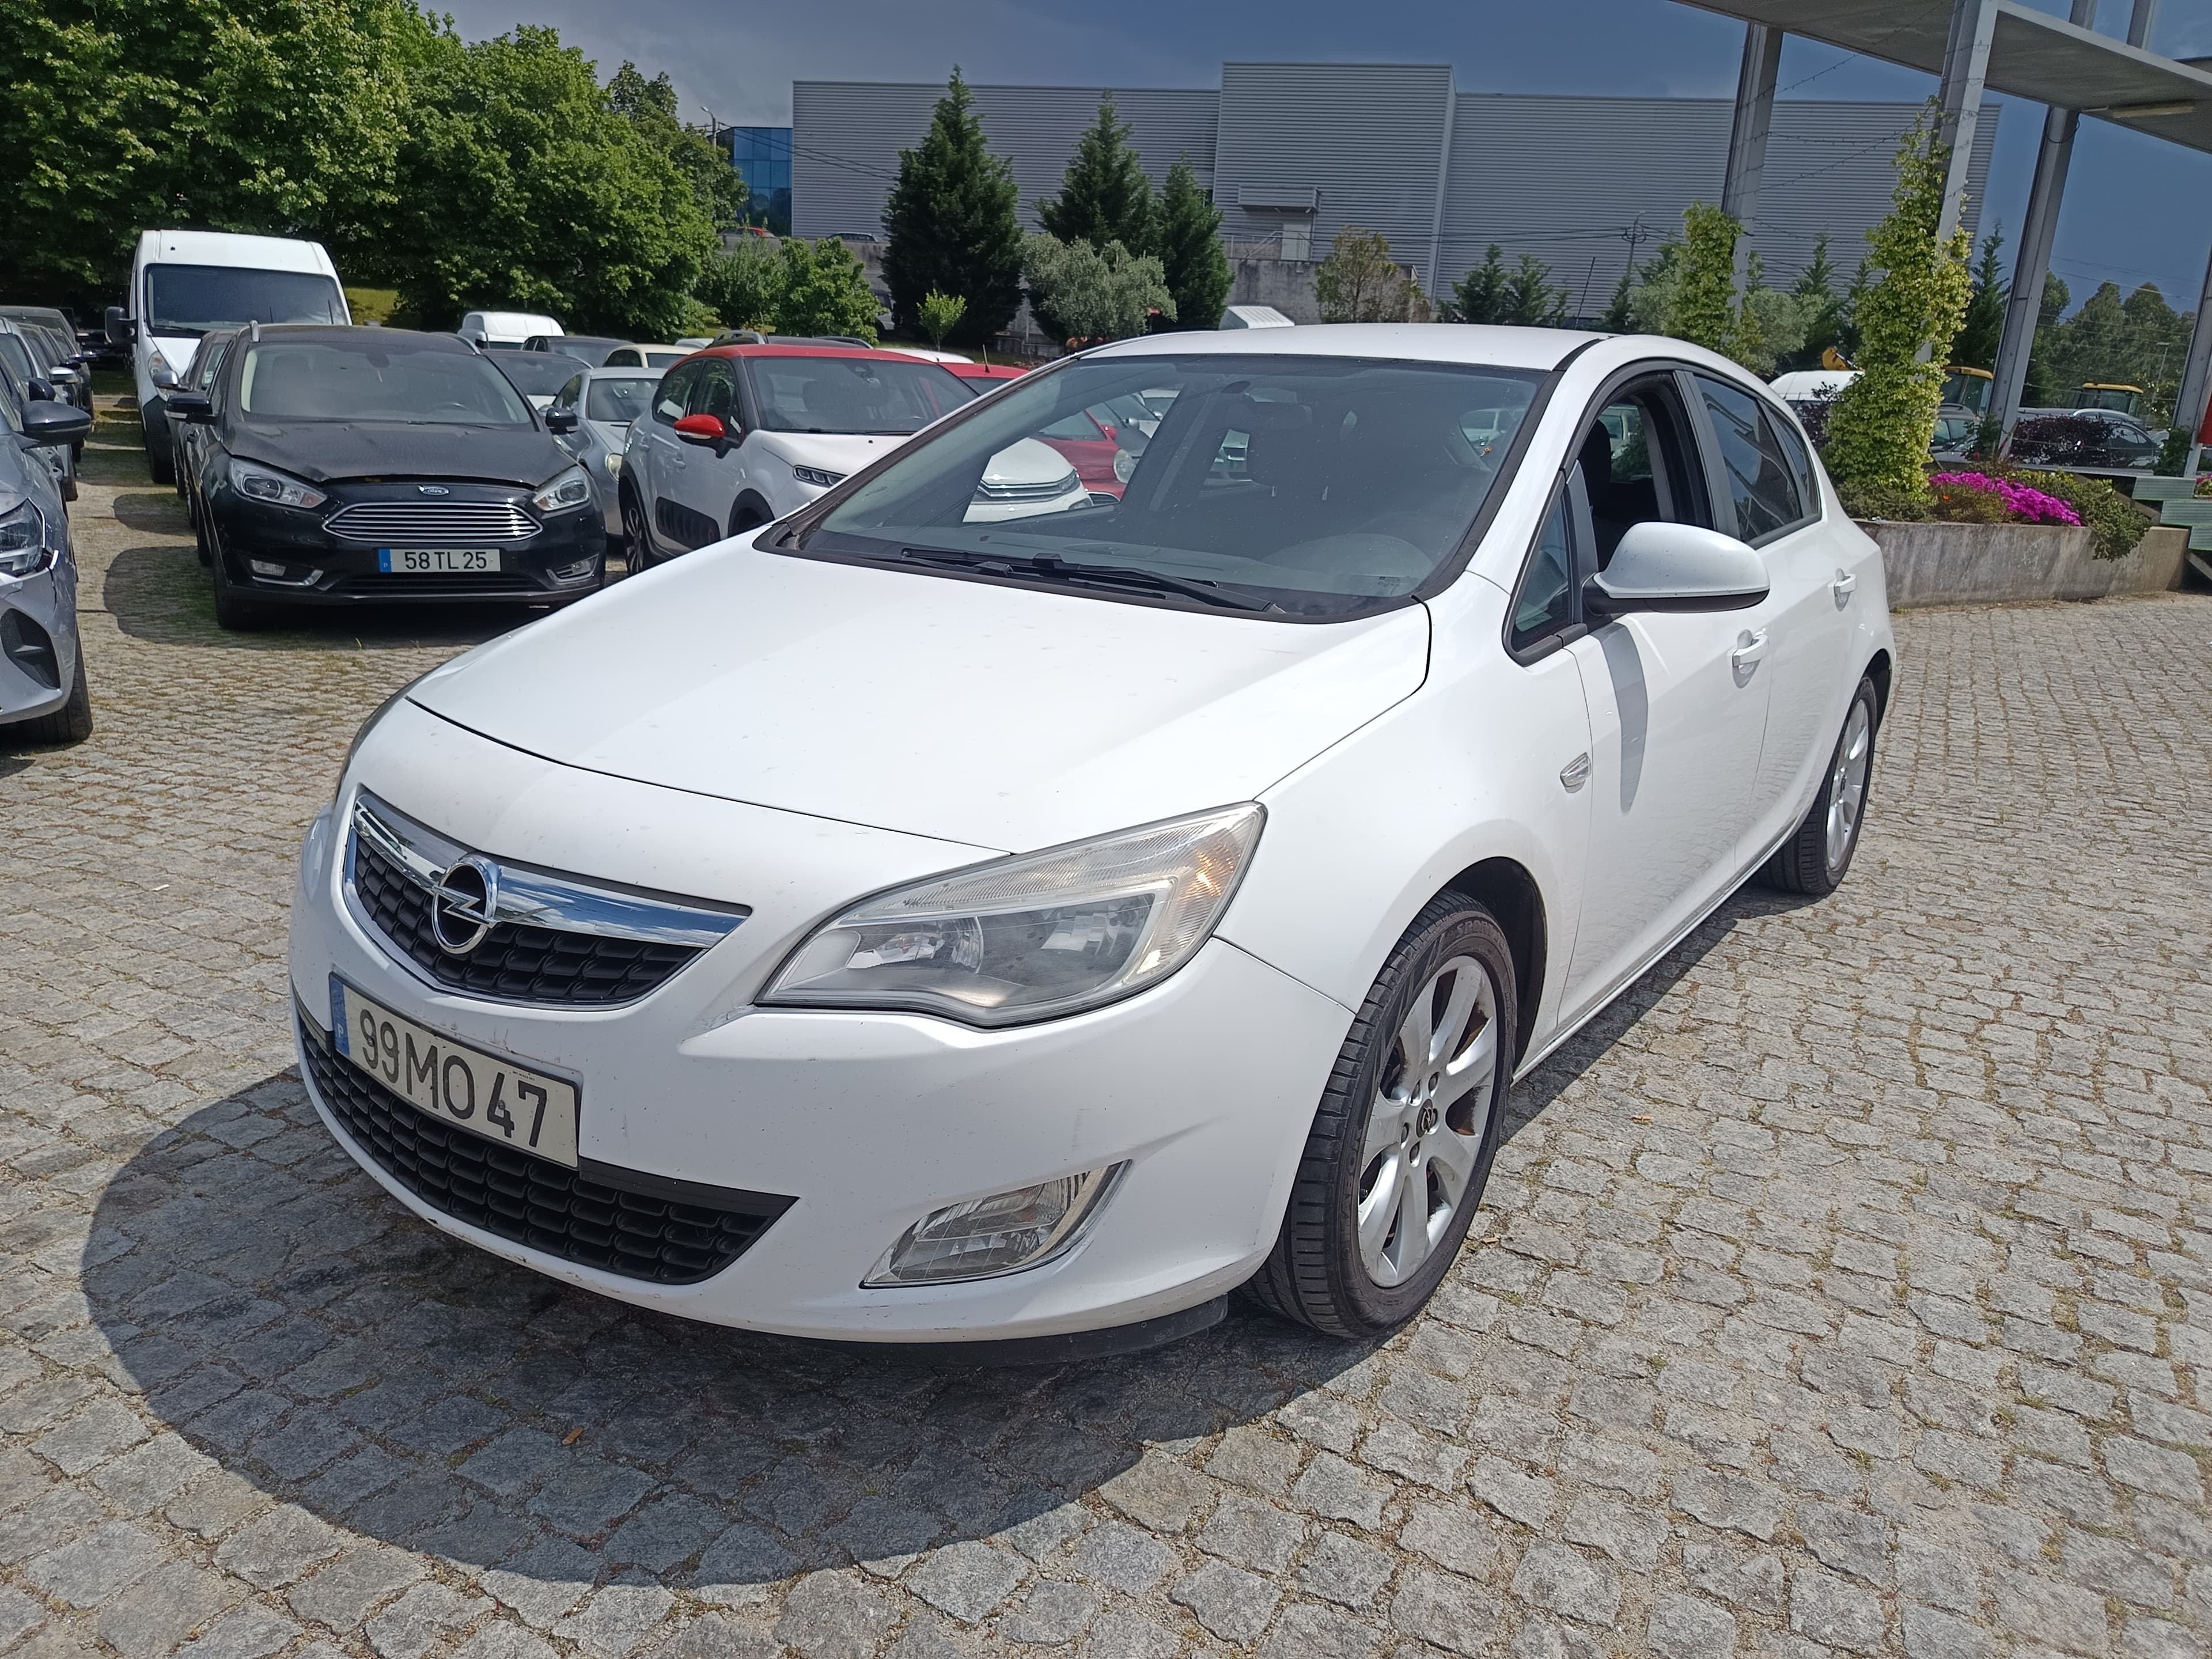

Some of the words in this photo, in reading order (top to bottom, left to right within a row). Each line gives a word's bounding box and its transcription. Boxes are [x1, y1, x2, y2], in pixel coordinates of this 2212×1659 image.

[404, 552, 430, 570] 58
[434, 552, 459, 570] TL
[463, 552, 487, 569] 25
[337, 1023, 343, 1039] P
[360, 1009, 399, 1084] 99
[487, 1072, 547, 1147] 47
